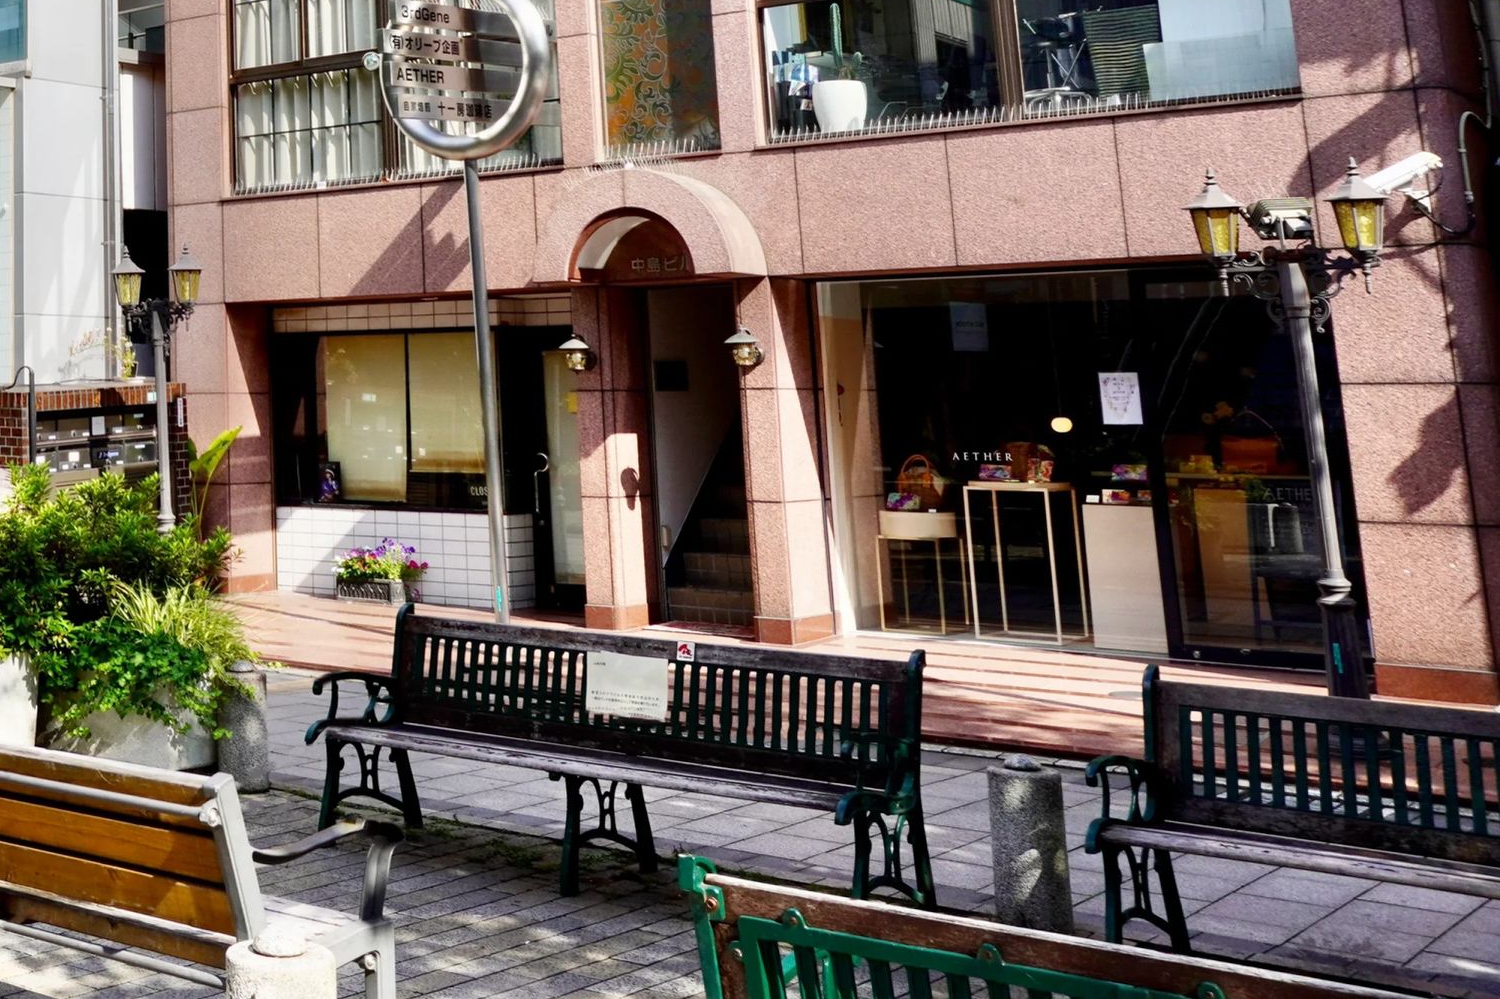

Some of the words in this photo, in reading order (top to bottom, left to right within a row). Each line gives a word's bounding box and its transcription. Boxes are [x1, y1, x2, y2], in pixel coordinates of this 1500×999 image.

[401, 4, 450, 24] 3rdGene
[397, 68, 445, 84] AETHER
[952, 451, 1013, 462] AETHER
[1262, 487, 1312, 501] AETHE
